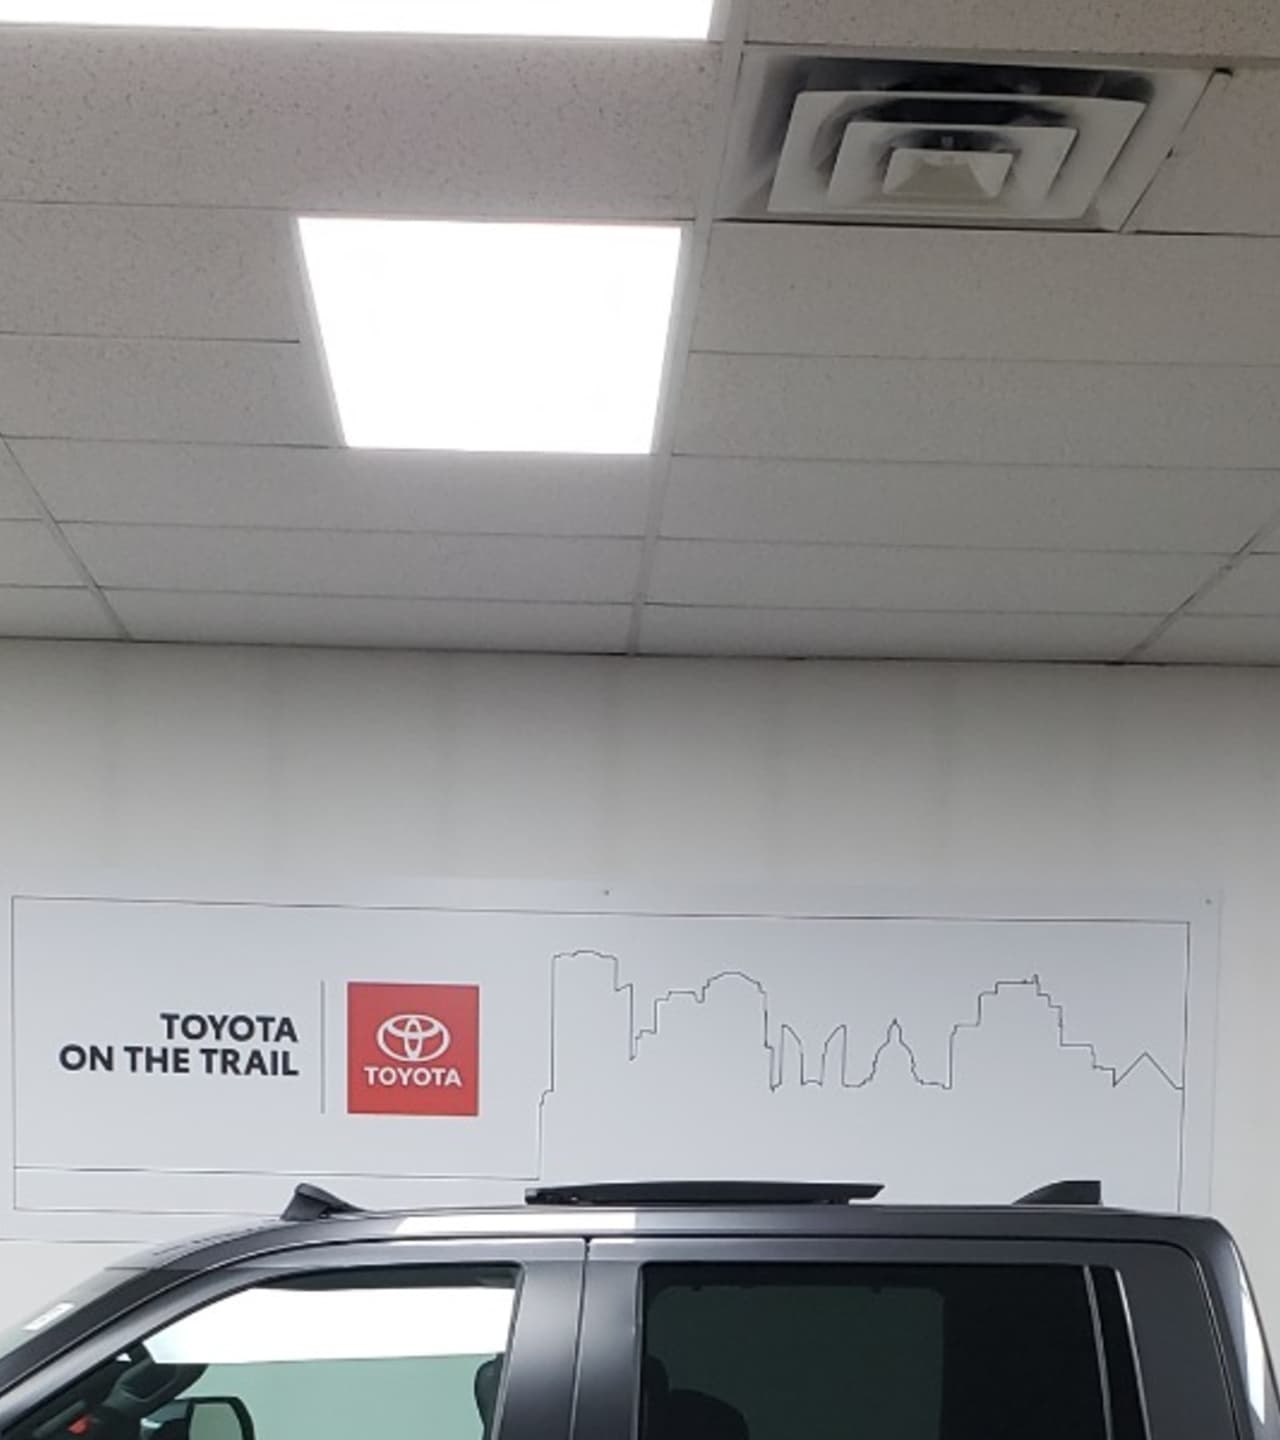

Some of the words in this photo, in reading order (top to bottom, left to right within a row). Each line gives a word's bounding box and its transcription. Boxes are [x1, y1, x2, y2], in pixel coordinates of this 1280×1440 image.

[160, 1012, 299, 1043] TOYOTA
[59, 1043, 114, 1072] ON
[123, 1045, 190, 1074] THE
[199, 1047, 300, 1076] TRAIL
[364, 1066, 462, 1087] TOYOTA
